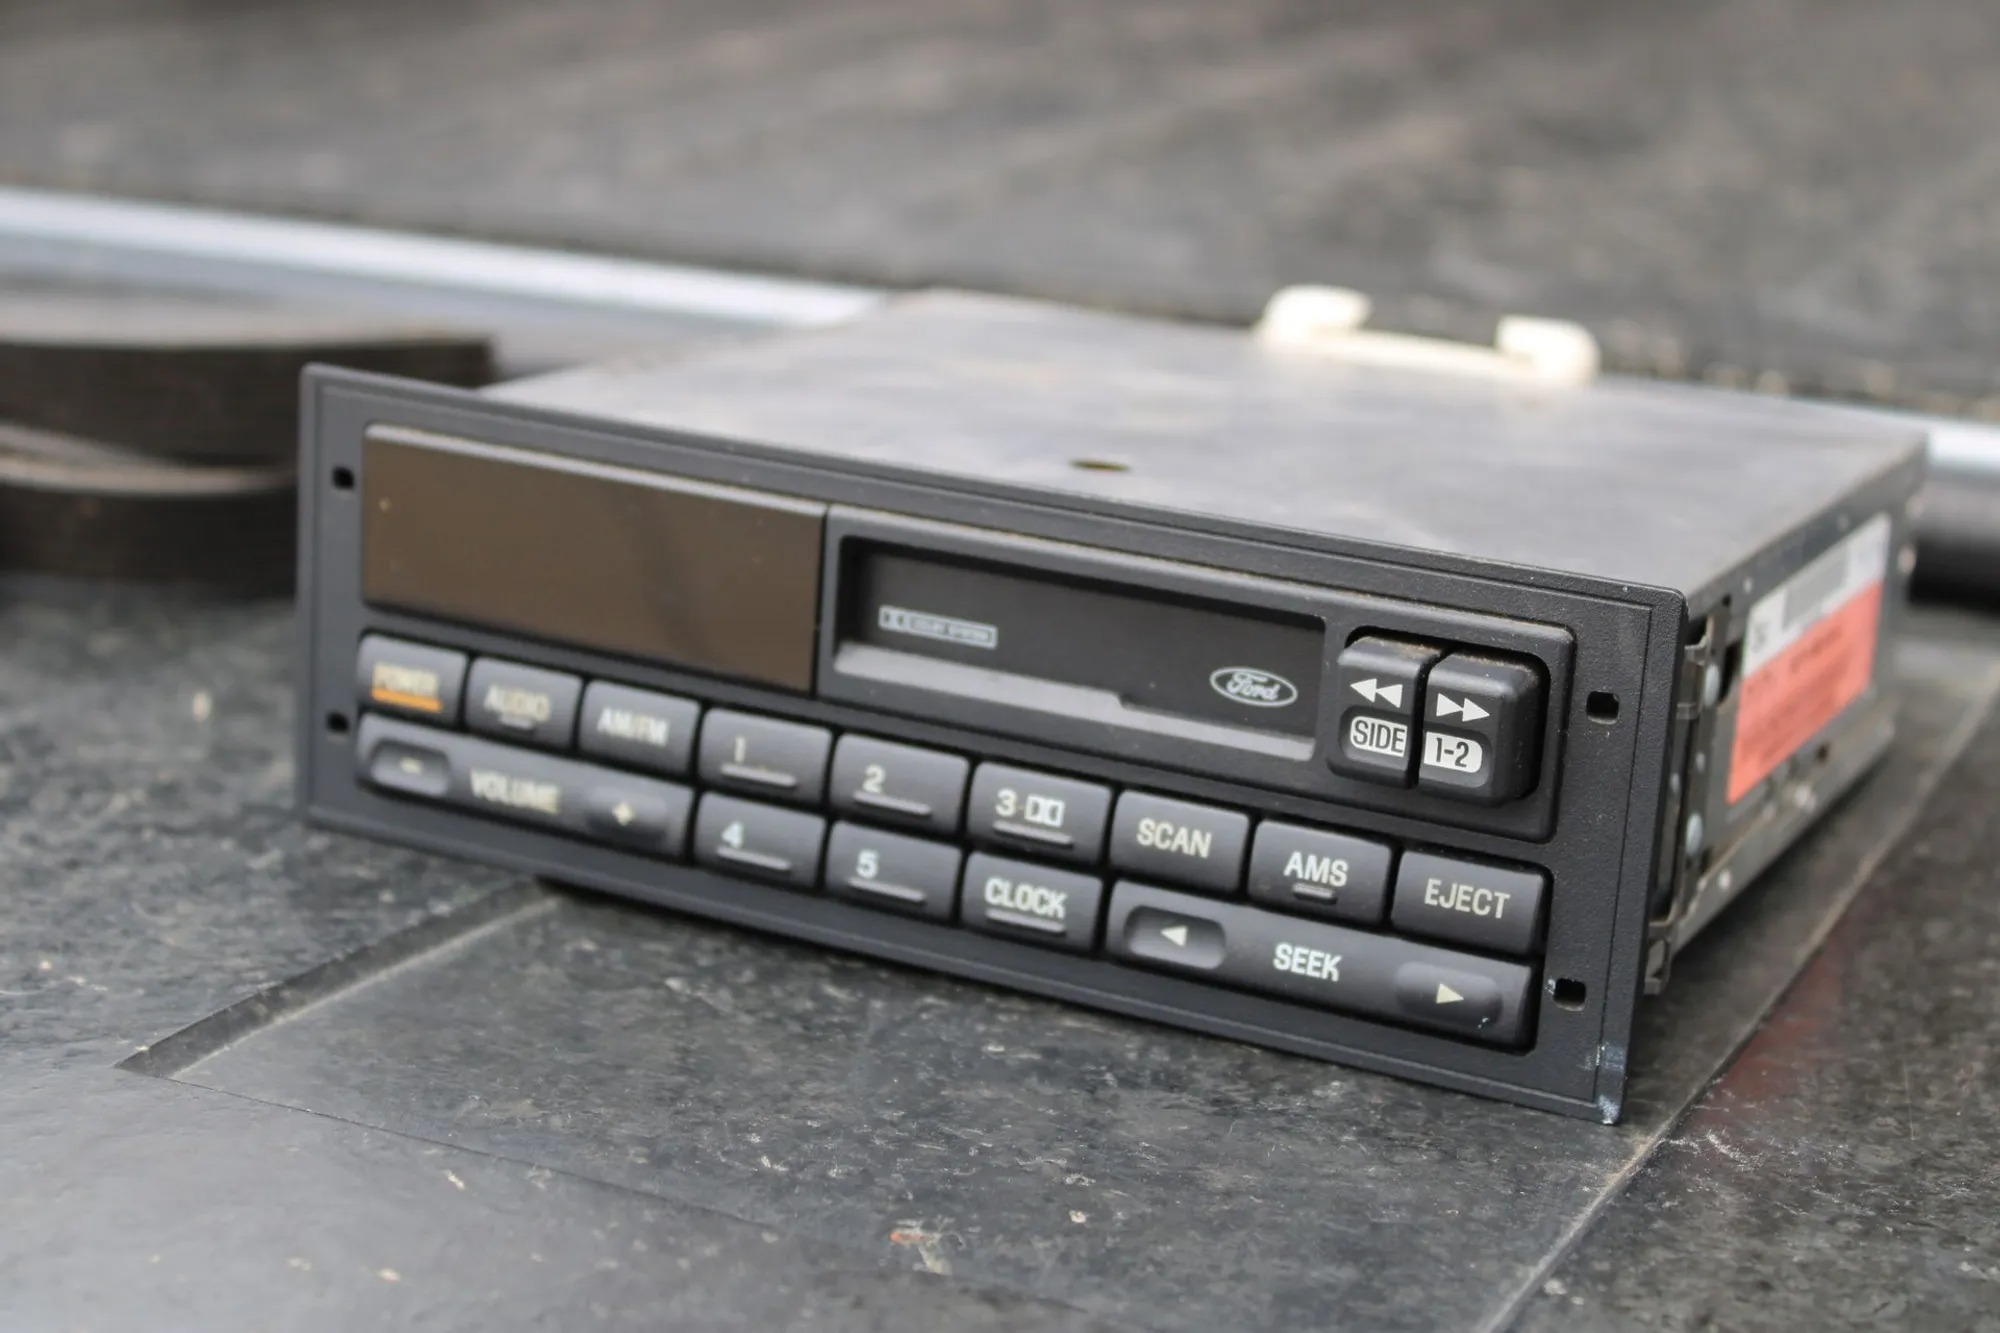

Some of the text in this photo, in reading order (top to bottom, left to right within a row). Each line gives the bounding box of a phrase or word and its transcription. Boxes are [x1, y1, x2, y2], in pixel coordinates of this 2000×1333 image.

[1225, 672, 1280, 702] Ford
[1353, 719, 1470, 768] SIDE 1-2
[469, 767, 561, 816] VOLUME
[862, 764, 886, 793] 2
[995, 788, 1017, 817] 3
[720, 821, 743, 849] 4
[1137, 817, 1212, 859] SCAN
[856, 849, 879, 879] 5
[1283, 850, 1349, 888] AMS
[984, 876, 1069, 919] CLOCK
[1424, 877, 1511, 919] EJECT
[1273, 941, 1344, 982] SEEK
